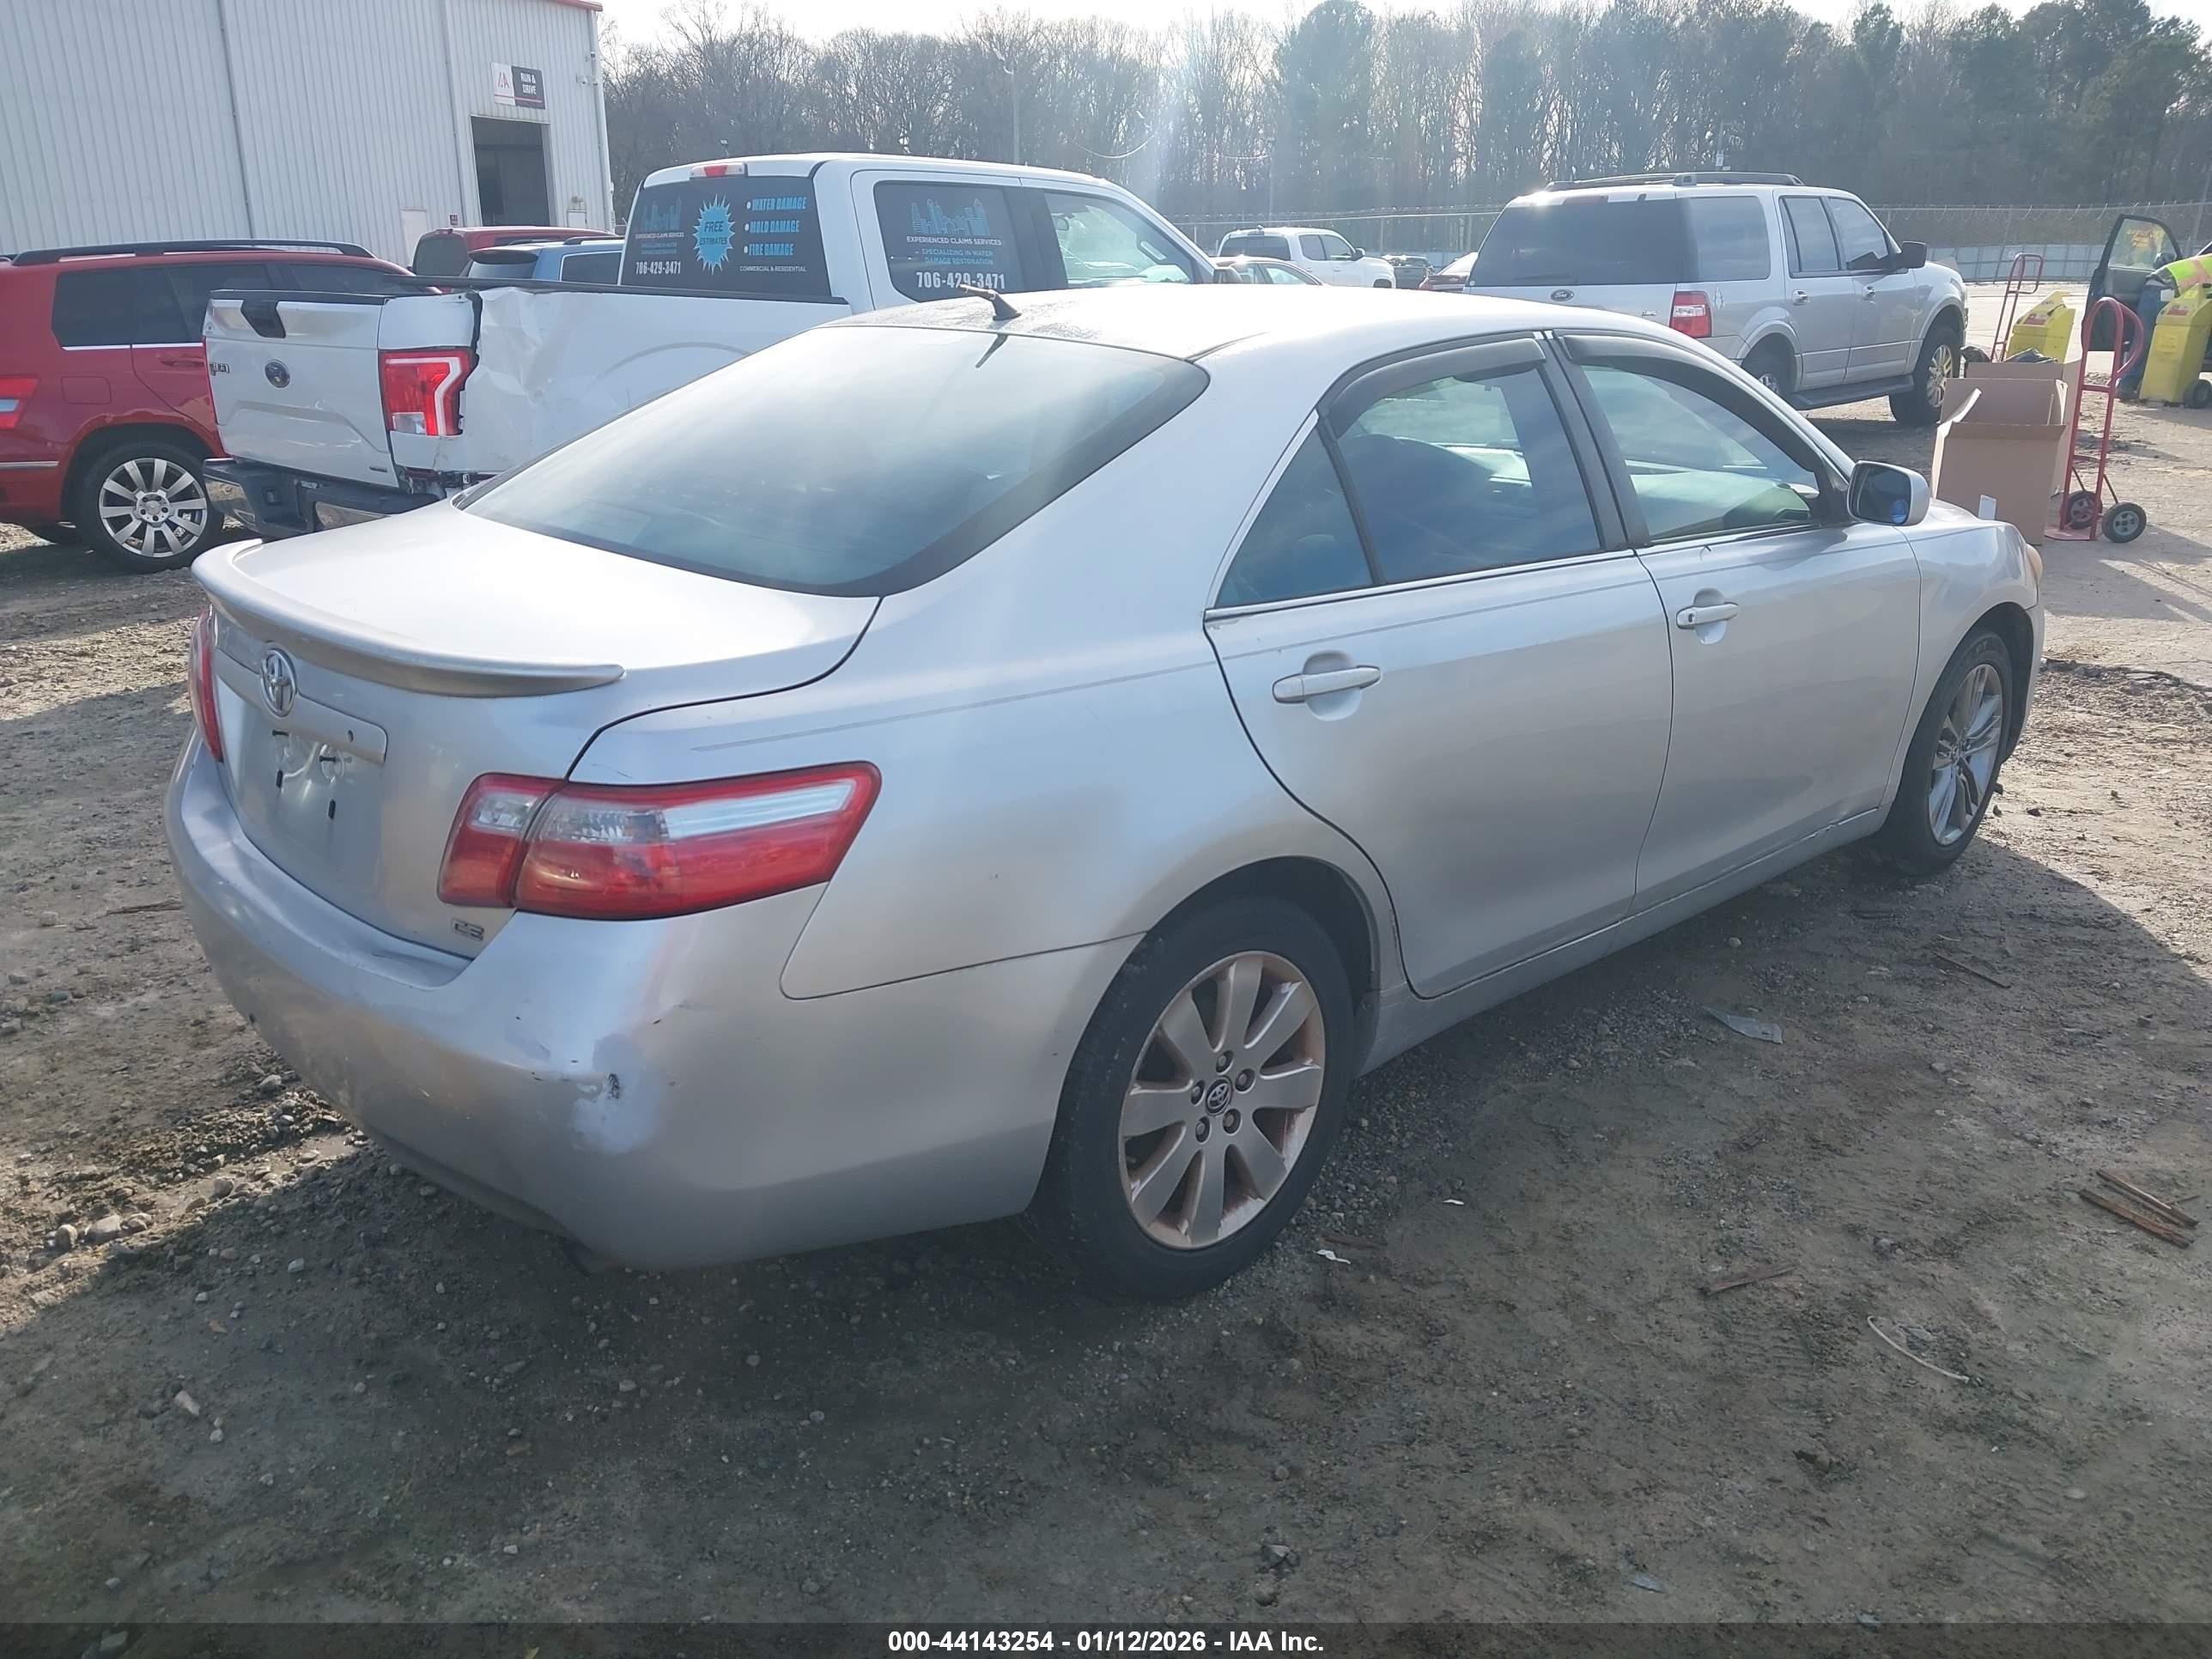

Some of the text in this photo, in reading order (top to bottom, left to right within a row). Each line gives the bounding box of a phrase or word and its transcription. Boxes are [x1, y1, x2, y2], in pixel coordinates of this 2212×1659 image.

[752, 197, 806, 211] WATER DAMAGE
[704, 221, 725, 233] FREE
[750, 220, 799, 234] MOLD DAMAGE
[699, 237, 728, 246] ESTIMATES
[749, 243, 794, 256] FIRE DAMAGE
[635, 261, 682, 275] 706-429-3471
[915, 271, 1006, 289] 706-429-3471
